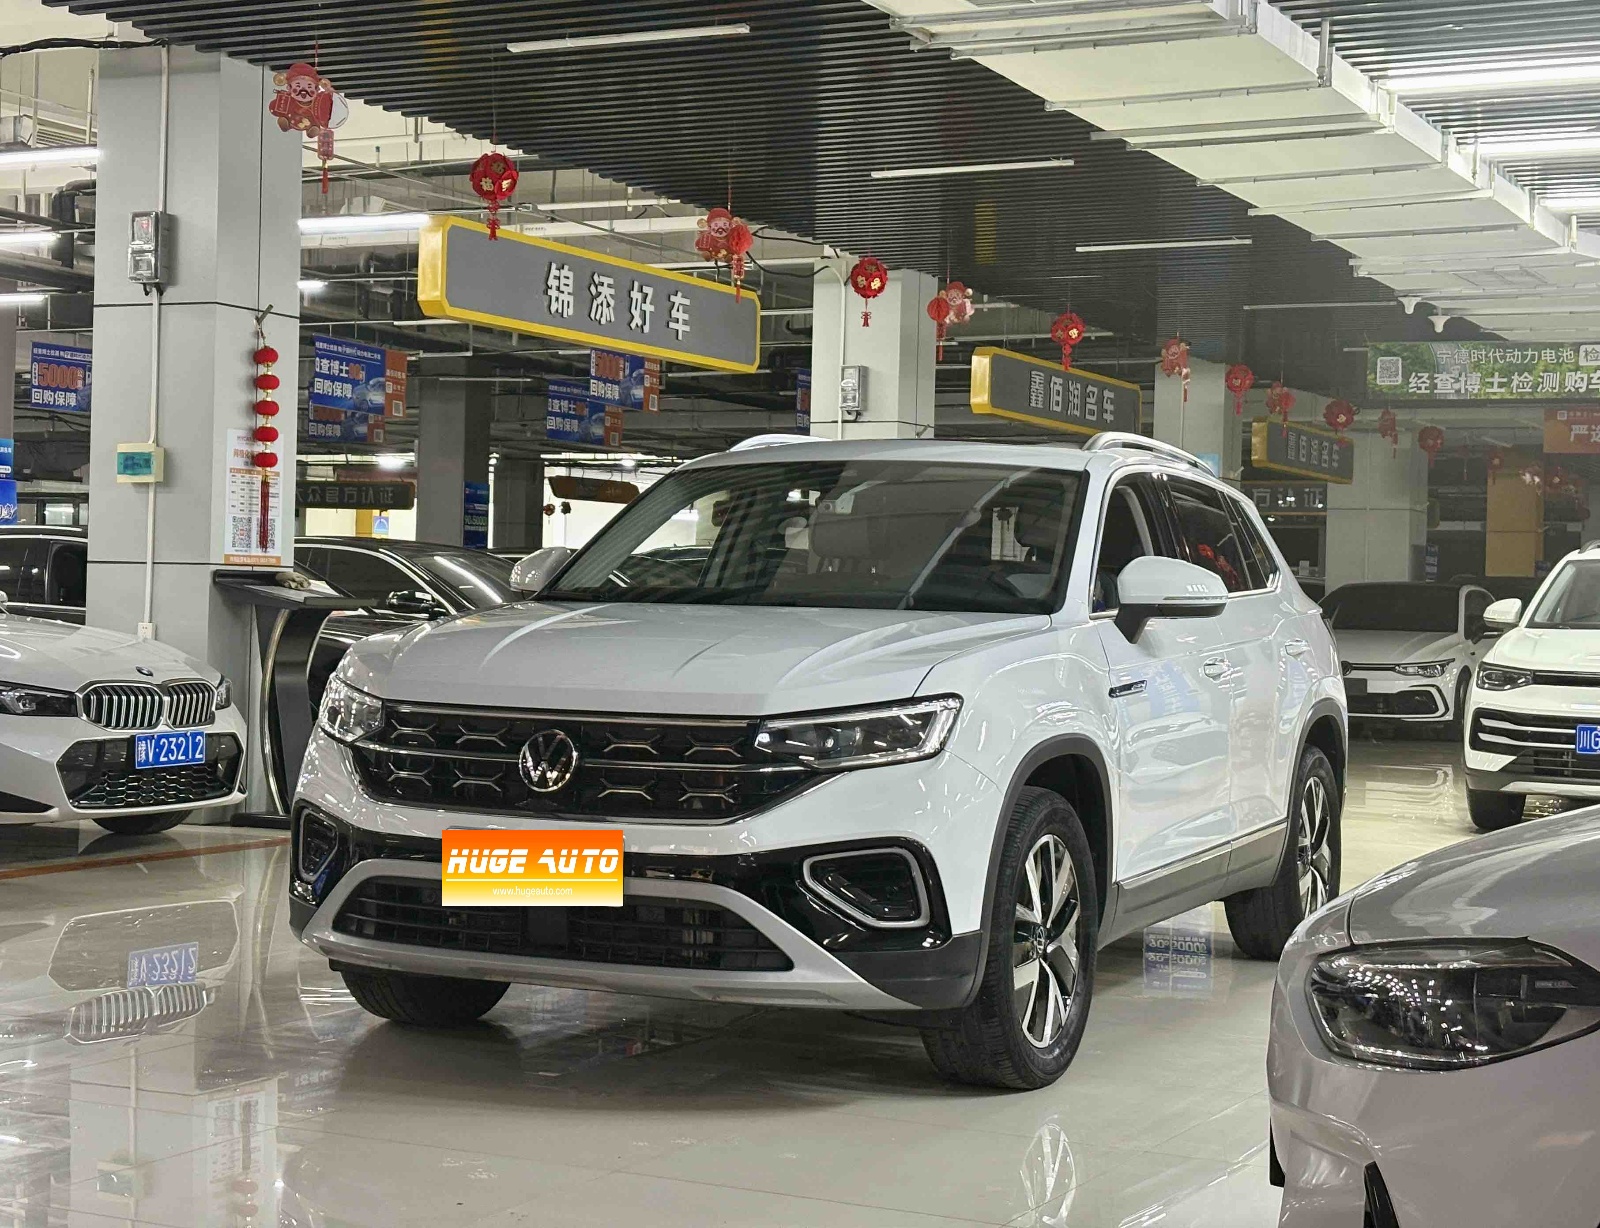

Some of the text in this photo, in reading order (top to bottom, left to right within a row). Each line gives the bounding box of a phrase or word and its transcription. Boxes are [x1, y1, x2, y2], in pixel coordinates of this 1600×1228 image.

[547, 262, 691, 341] 锦添好车
[1437, 348, 1575, 365] 宁德时代动力电池
[31, 388, 77, 408] 回购保障
[314, 378, 353, 399] 回购保障
[1029, 370, 1115, 424] 鑫佰润名车
